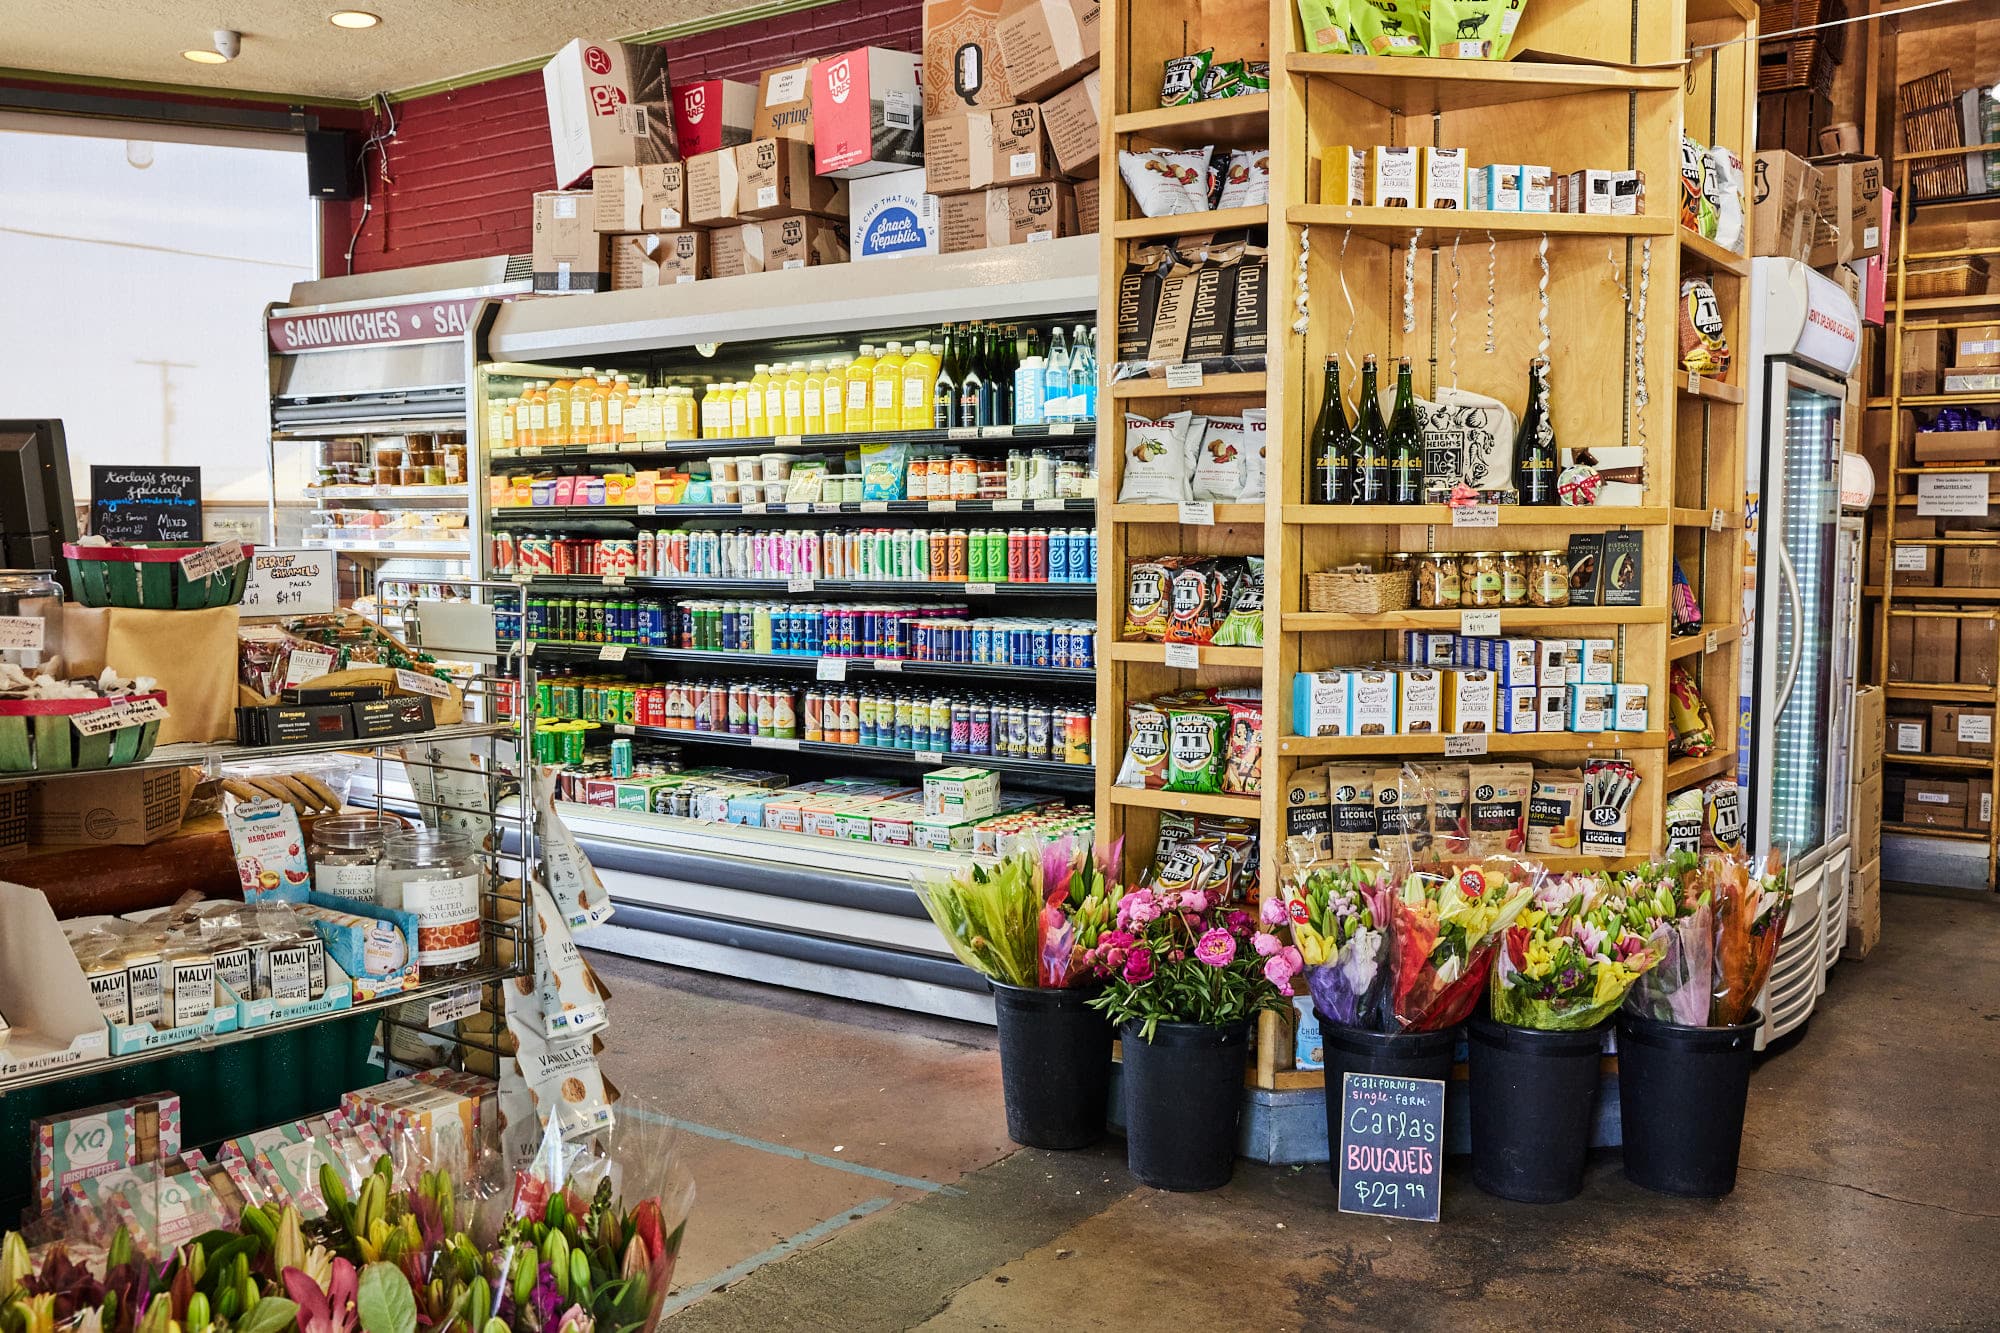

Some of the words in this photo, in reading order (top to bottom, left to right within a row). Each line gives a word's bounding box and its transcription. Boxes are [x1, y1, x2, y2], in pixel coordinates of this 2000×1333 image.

[864, 203, 879, 223] CHIP
[881, 195, 902, 205] THAT
[878, 216, 912, 233] Snack
[284, 311, 400, 347] SANDWICHES
[1251, 423, 1267, 432] TO
[256, 555, 295, 570] BEQUET
[271, 564, 319, 579] CARAMELS
[1132, 574, 1160, 582] ROUTE
[1134, 583, 1151, 594] 11
[295, 656, 327, 667] BEQUET
[1136, 723, 1164, 732] ROUTE
[1176, 725, 1208, 733] ROUTE
[1140, 733, 1160, 744] 11
[1180, 736, 1203, 747] 11
[1133, 747, 1161, 755] CHIPS
[1293, 812, 1327, 822] LICORICE
[1478, 808, 1515, 818] LICORICE
[1720, 810, 1737, 826] 11
[248, 834, 265, 843] HARD
[266, 830, 286, 841] CANDY
[1586, 835, 1623, 844] LICORICE
[1721, 830, 1740, 841] CHIPS
[1169, 862, 1188, 872] 11
[1160, 873, 1185, 882] CHIPS
[333, 888, 373, 896] ESPRESSO
[430, 902, 462, 912] SALTED
[441, 906, 477, 919] CARAMELS
[216, 953, 247, 970] MALVI
[274, 952, 305, 967] MALVI
[178, 968, 212, 983] MALVI
[91, 976, 124, 994] MALVI
[275, 989, 308, 999] CHOCOLATE
[179, 1002, 210, 1011] VANILLA
[539, 1047, 580, 1066] VANILLA
[541, 1061, 571, 1076] CRUNCHY
[1350, 1107, 1436, 1142] Carla's
[63, 1169, 86, 1184] IRISH
[86, 1161, 118, 1178] COFFEE
[1354, 1180, 1426, 1209] $29.99
